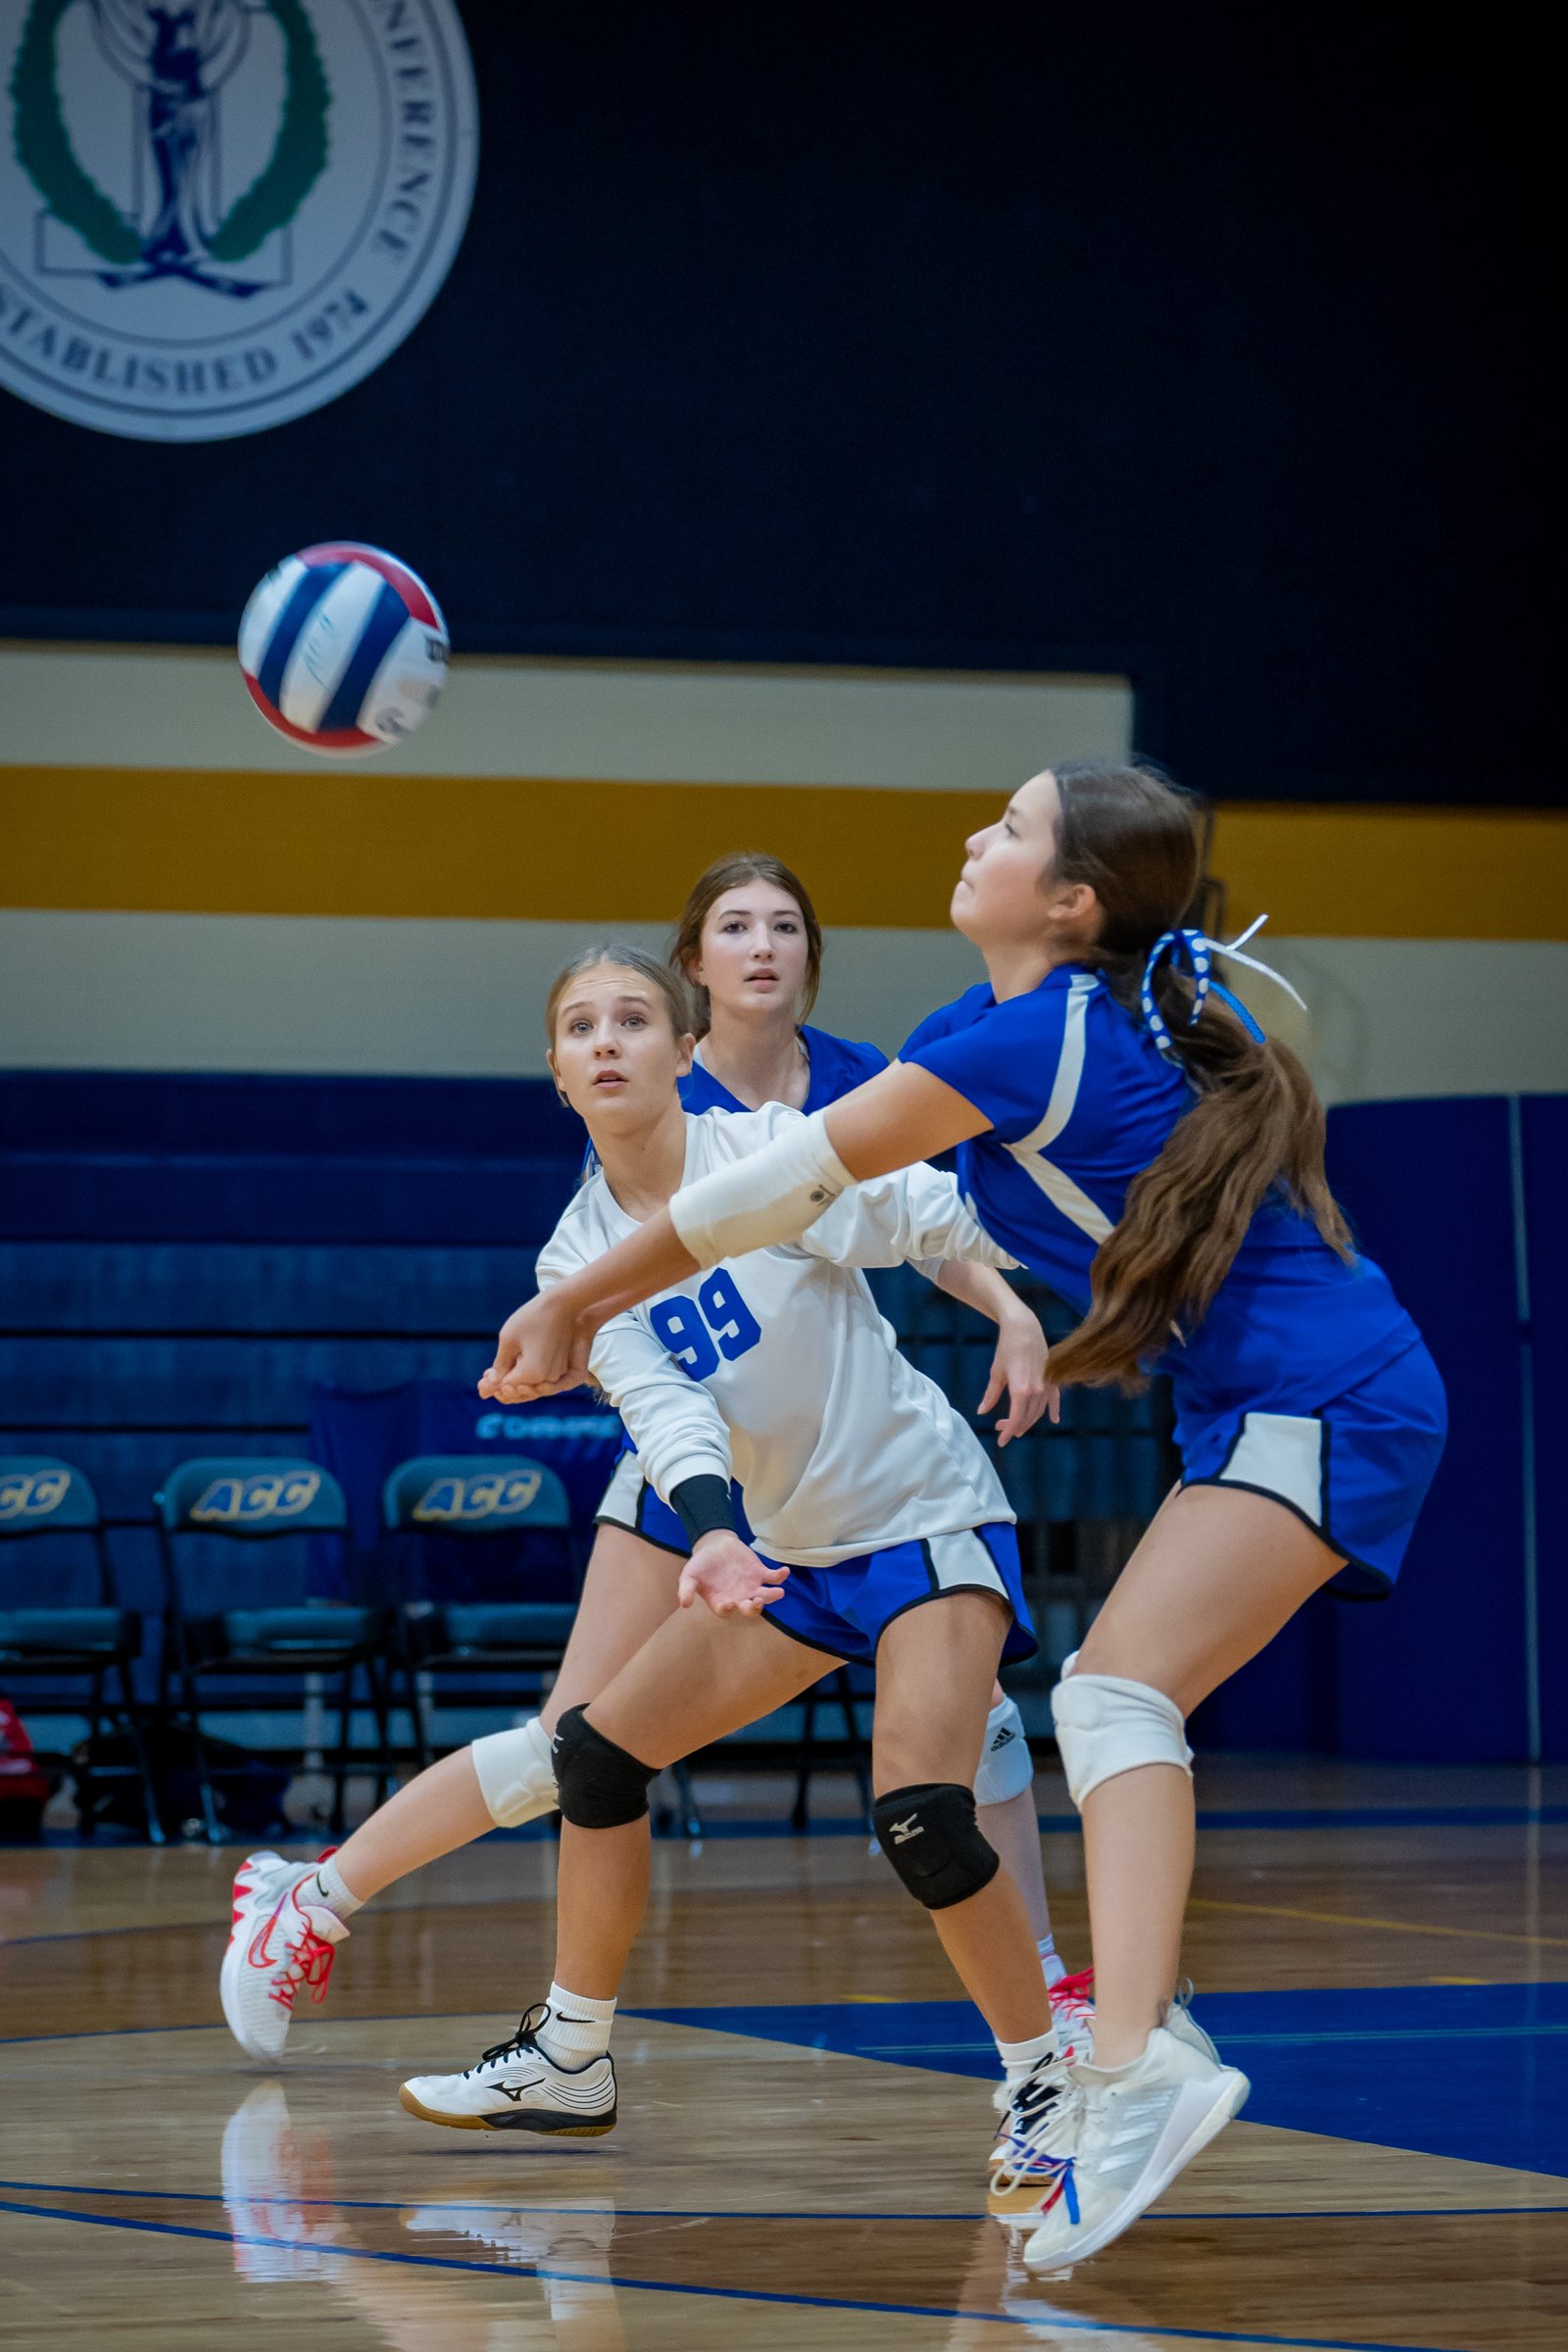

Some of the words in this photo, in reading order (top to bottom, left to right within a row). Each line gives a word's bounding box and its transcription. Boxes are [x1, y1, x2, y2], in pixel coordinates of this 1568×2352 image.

[292, 289, 369, 362] 1974
[650, 1267, 761, 1382] 99
[190, 1471, 321, 1522] ACC
[413, 1470, 543, 1522] ACC
